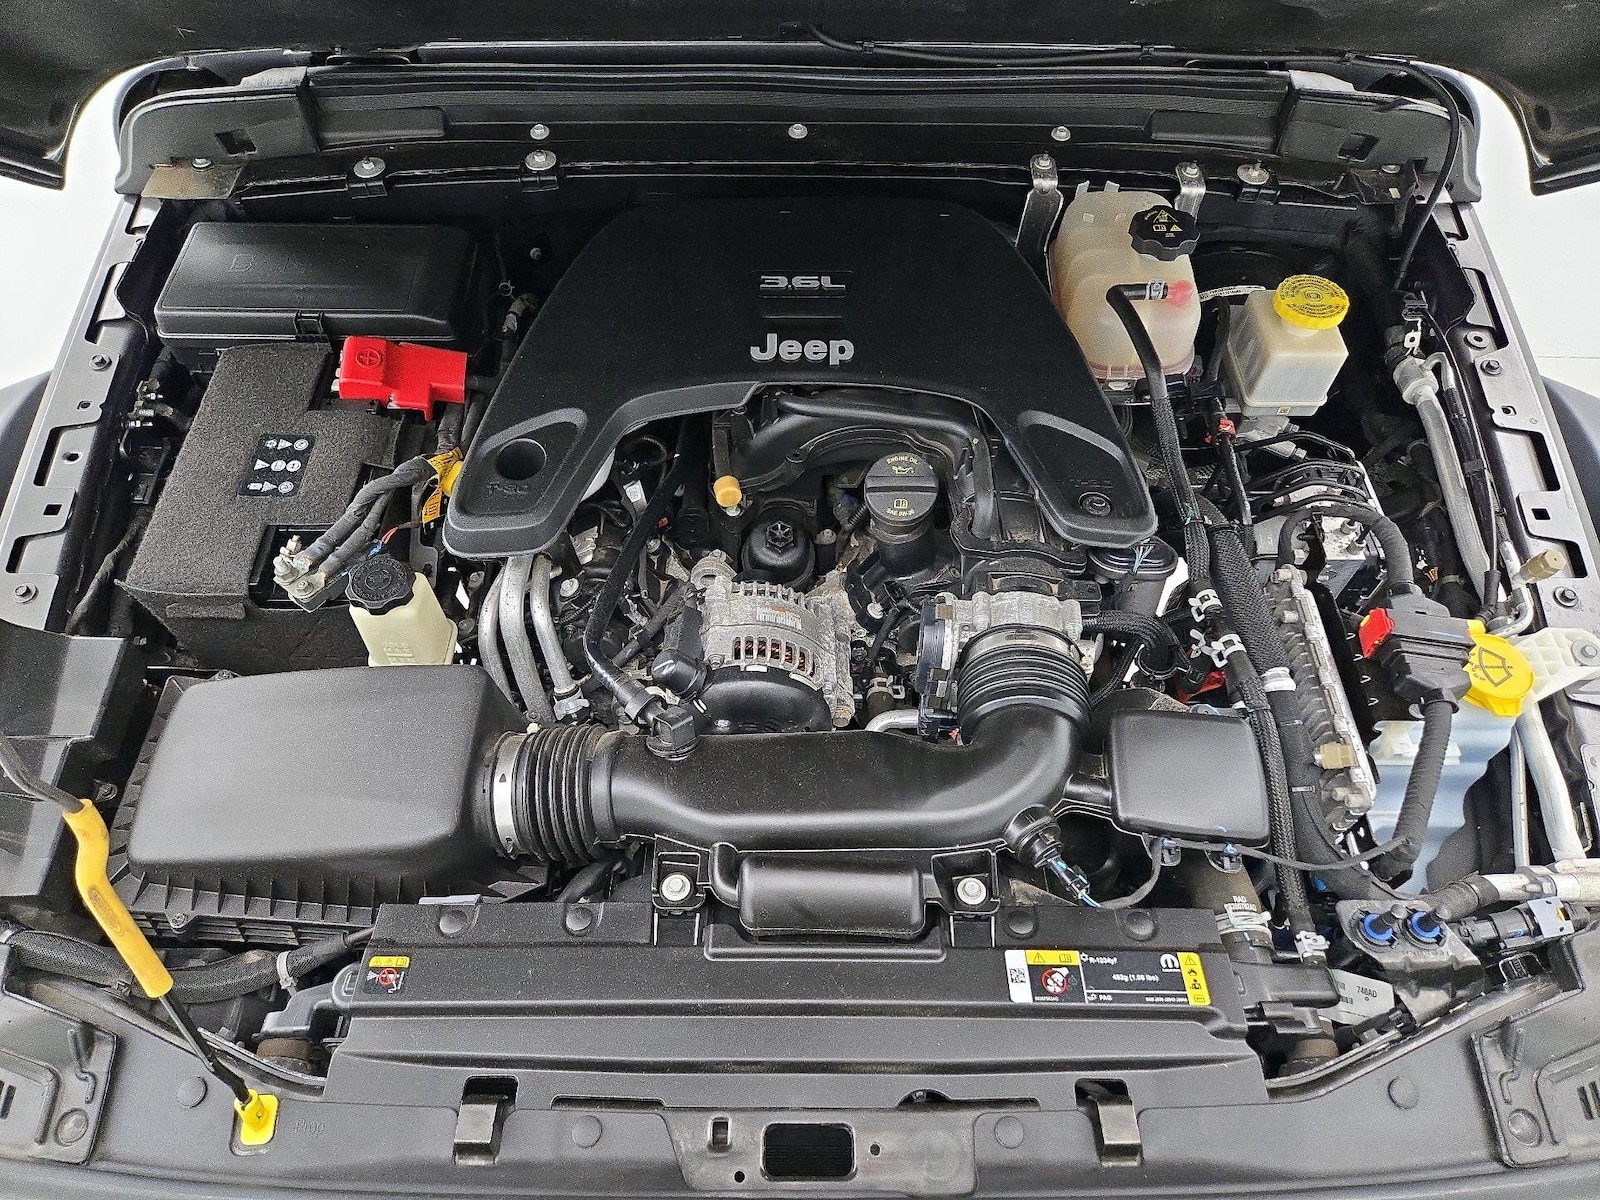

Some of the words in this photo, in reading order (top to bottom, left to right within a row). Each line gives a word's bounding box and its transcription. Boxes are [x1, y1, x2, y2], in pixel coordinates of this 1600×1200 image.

[760, 275, 846, 290] 3.6L
[750, 333, 855, 366] Jeep
[886, 455, 909, 465] ENGINE
[909, 457, 919, 465] OIL
[886, 507, 898, 516] SAE
[1088, 956, 1117, 965] R-1234yf
